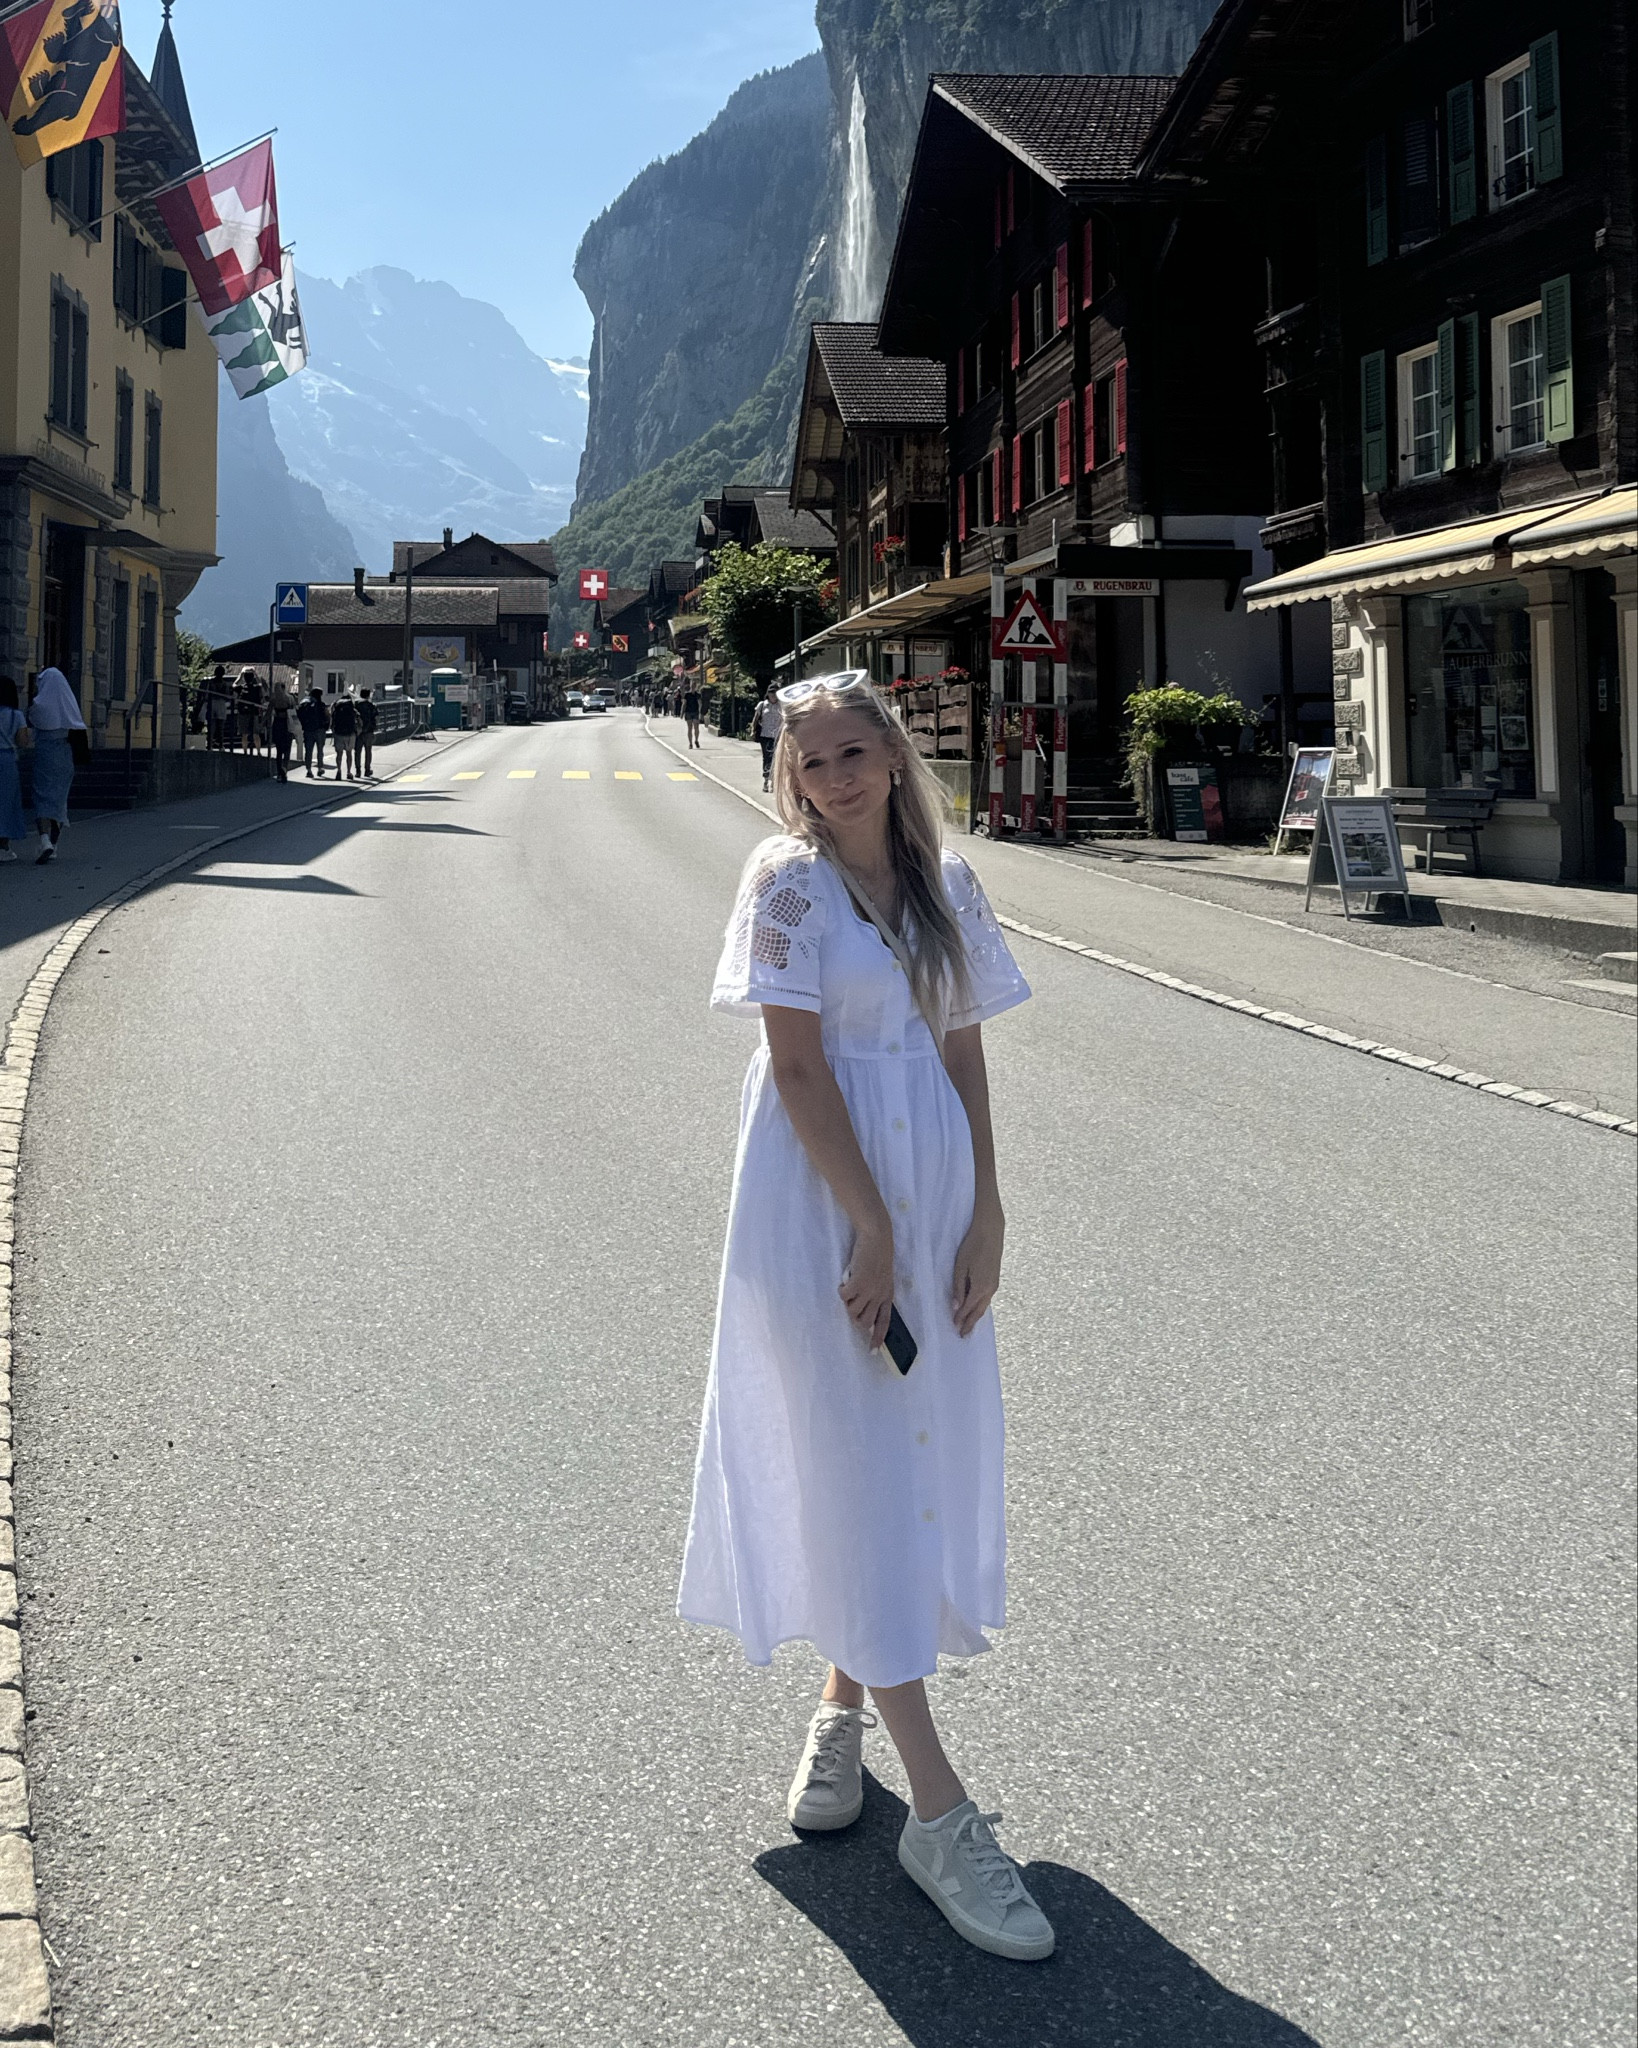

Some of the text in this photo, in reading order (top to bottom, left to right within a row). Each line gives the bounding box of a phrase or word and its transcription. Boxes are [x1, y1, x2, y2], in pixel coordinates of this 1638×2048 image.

[1441, 650, 1531, 671] LAUTERBRUNN
[1024, 713, 1034, 743] Frutiger
[992, 799, 1001, 827] rutiger
[1022, 800, 1033, 831] Frutiger
